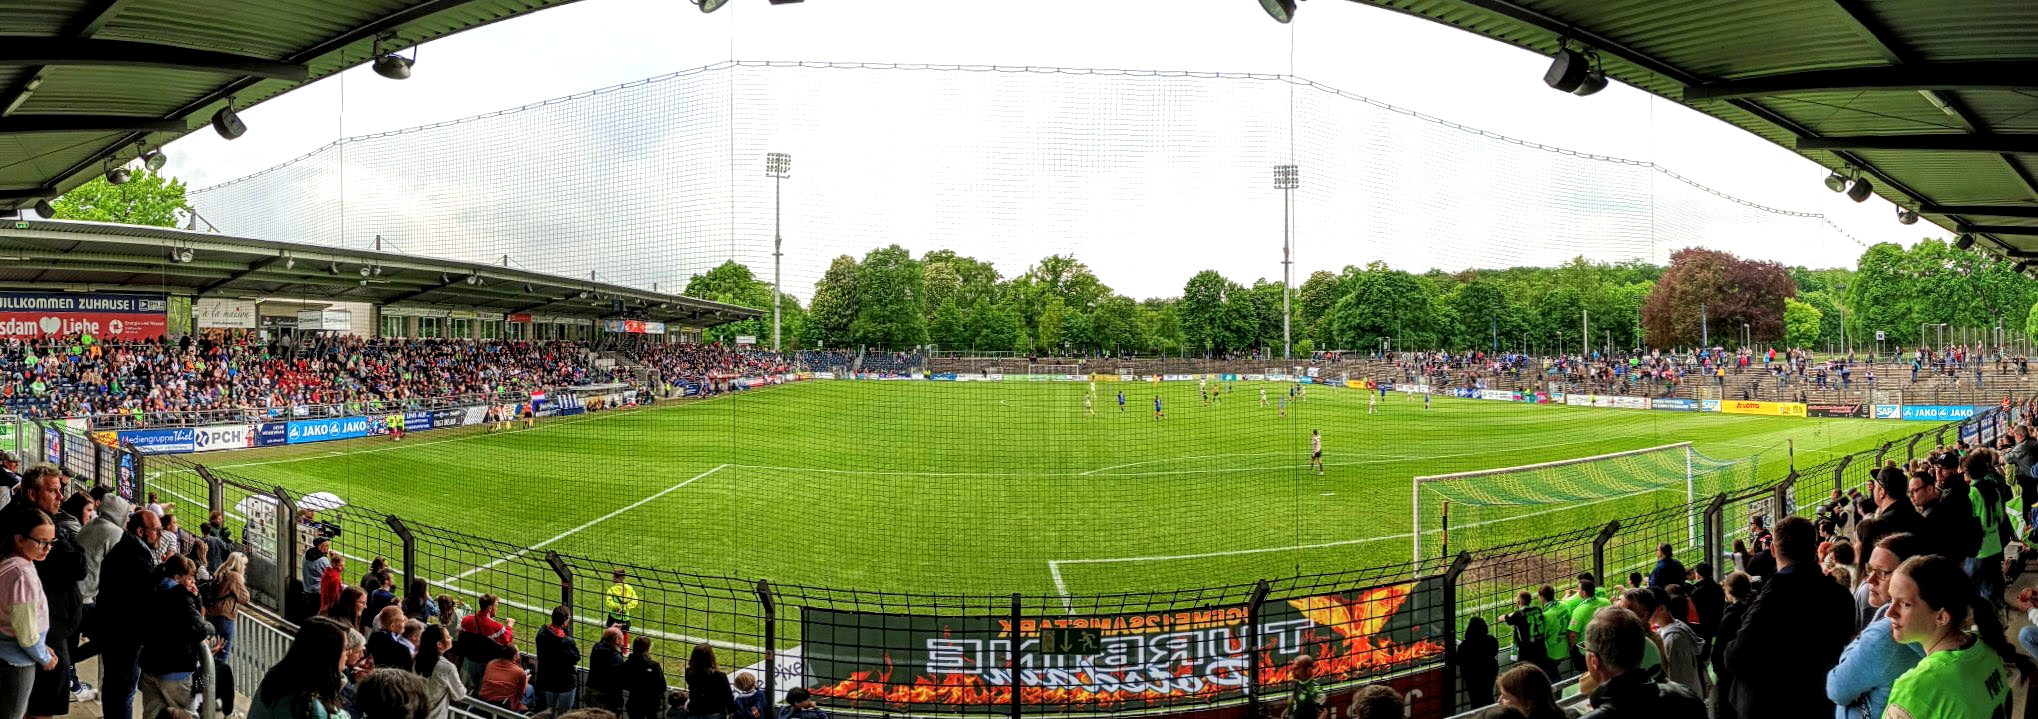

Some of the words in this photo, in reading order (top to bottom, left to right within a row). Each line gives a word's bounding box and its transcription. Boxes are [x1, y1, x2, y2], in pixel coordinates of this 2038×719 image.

[63, 318, 99, 335] Liebe
[1877, 407, 1892, 416] SAP
[1915, 408, 1937, 417] JAKO
[1950, 408, 1973, 417] JAKO
[303, 424, 328, 437] JAKO
[342, 421, 366, 433] JAKO
[173, 430, 193, 442] Thiel
[211, 431, 241, 444] PCH
